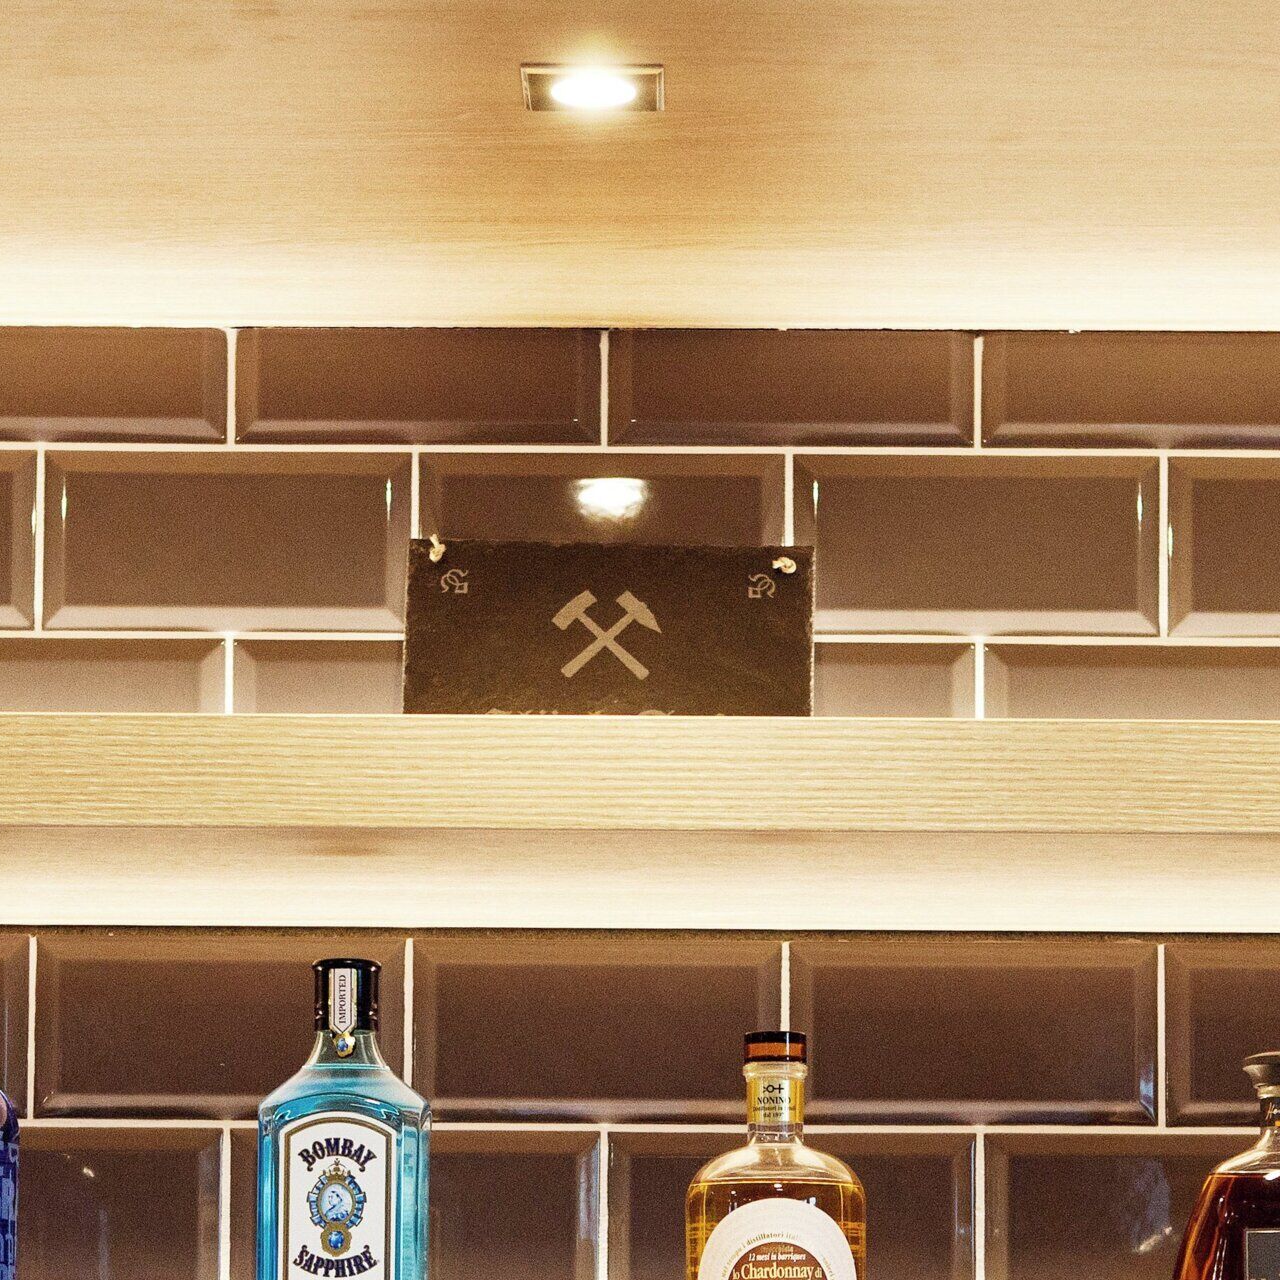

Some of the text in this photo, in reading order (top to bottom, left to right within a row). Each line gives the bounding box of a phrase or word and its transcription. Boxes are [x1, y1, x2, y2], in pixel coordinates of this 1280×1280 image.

[338, 974, 347, 1024] IMPORTED
[297, 1137, 377, 1172] BOMBAY
[292, 1245, 378, 1278] SAPPHIRE
[748, 1253, 756, 1261] 12
[814, 1268, 823, 1279] di
